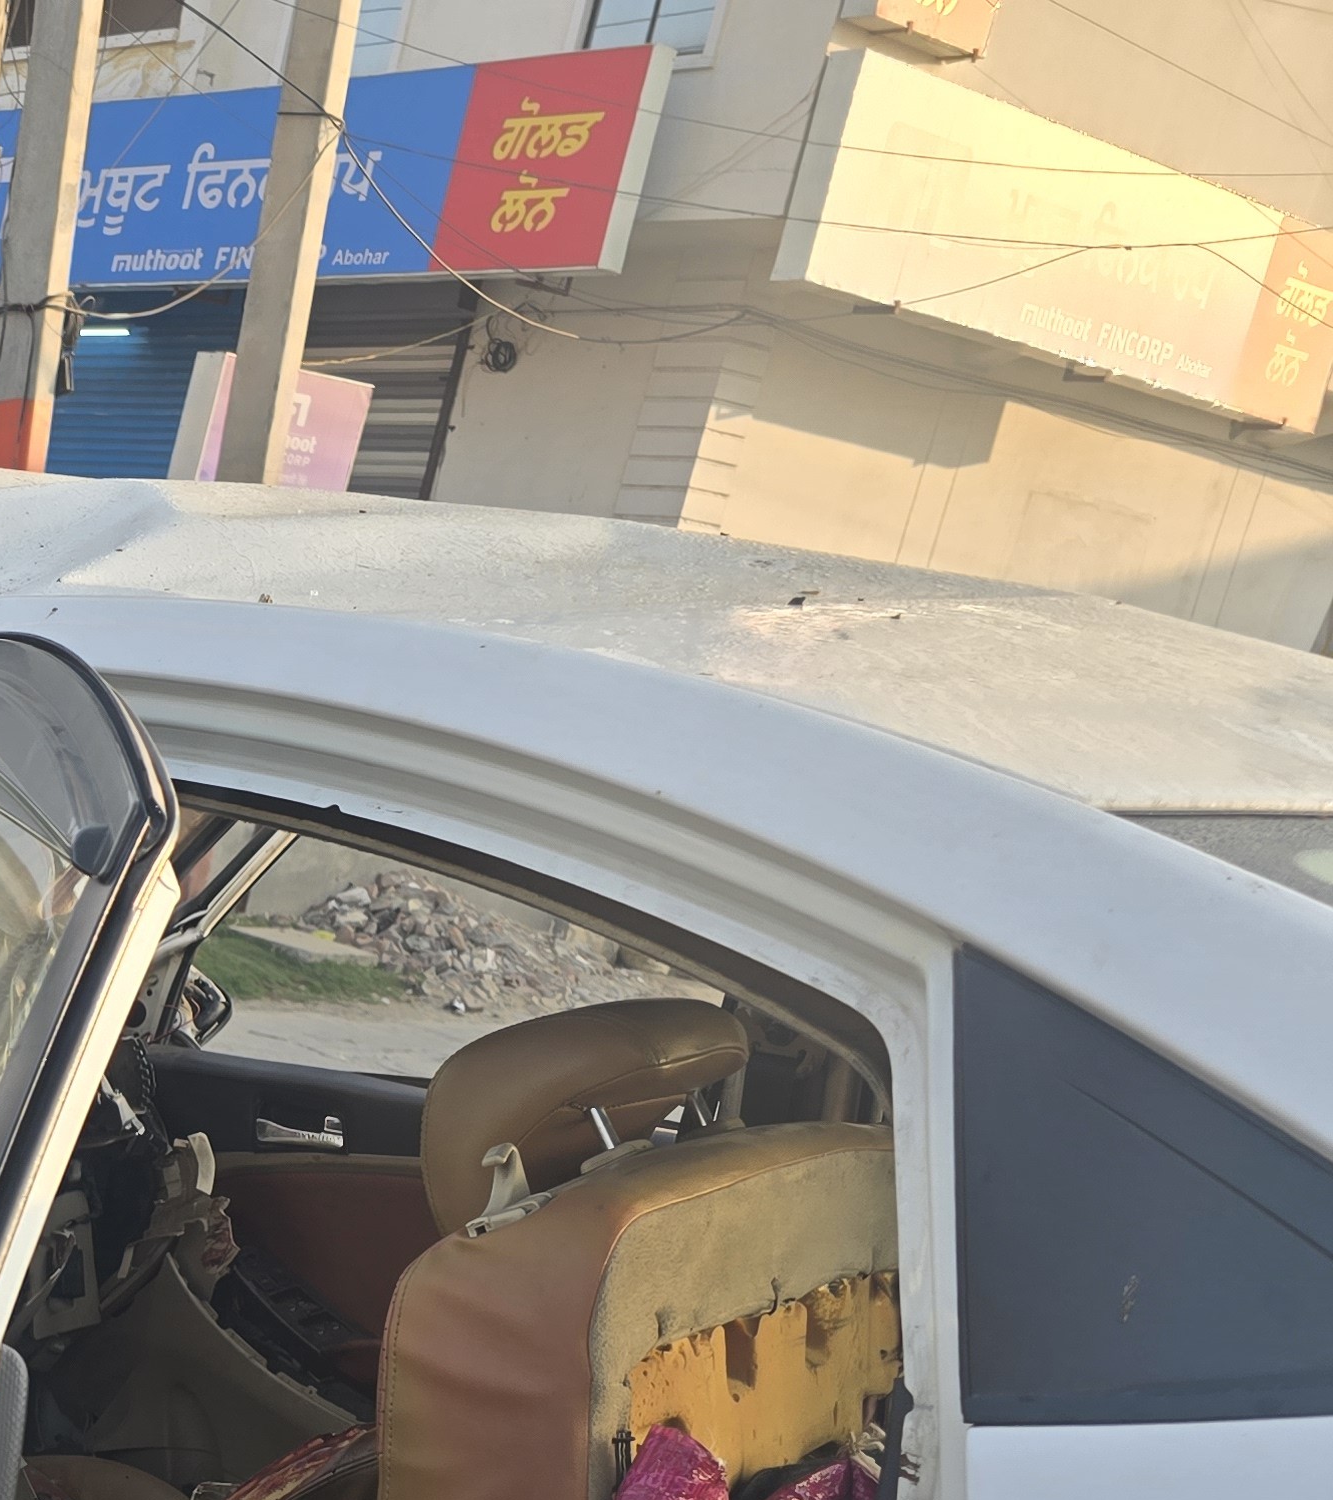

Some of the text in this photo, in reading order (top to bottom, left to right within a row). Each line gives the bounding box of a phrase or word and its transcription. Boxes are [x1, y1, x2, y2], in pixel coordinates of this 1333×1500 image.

[491, 170, 570, 234] ਲੋਨ
[111, 246, 204, 273] muthoot
[331, 248, 390, 267] Abohar
[1020, 301, 1213, 380] muthoot FINCORP Abohar
